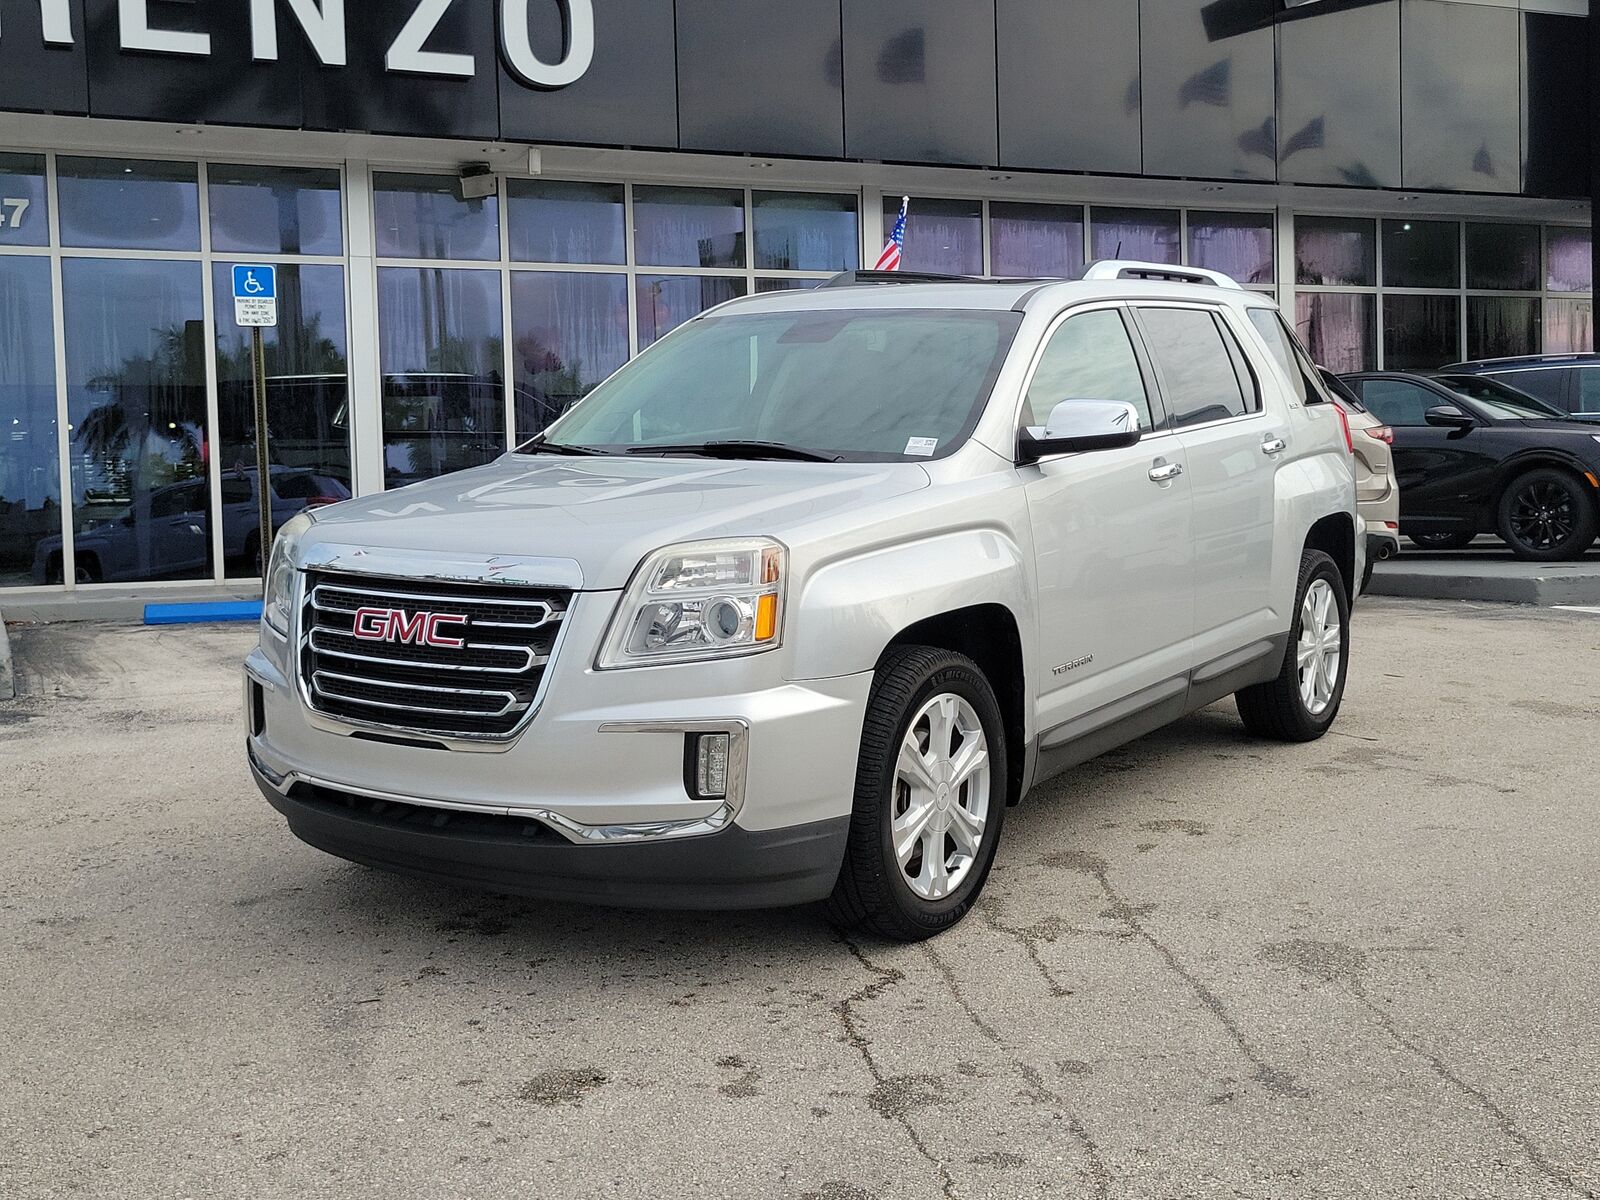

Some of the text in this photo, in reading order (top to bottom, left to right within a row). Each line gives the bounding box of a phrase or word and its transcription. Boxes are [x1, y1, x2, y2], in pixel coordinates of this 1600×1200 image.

[0, 198, 30, 228] 7
[353, 606, 468, 650] GMC
[1052, 653, 1093, 675] TERRAIN
